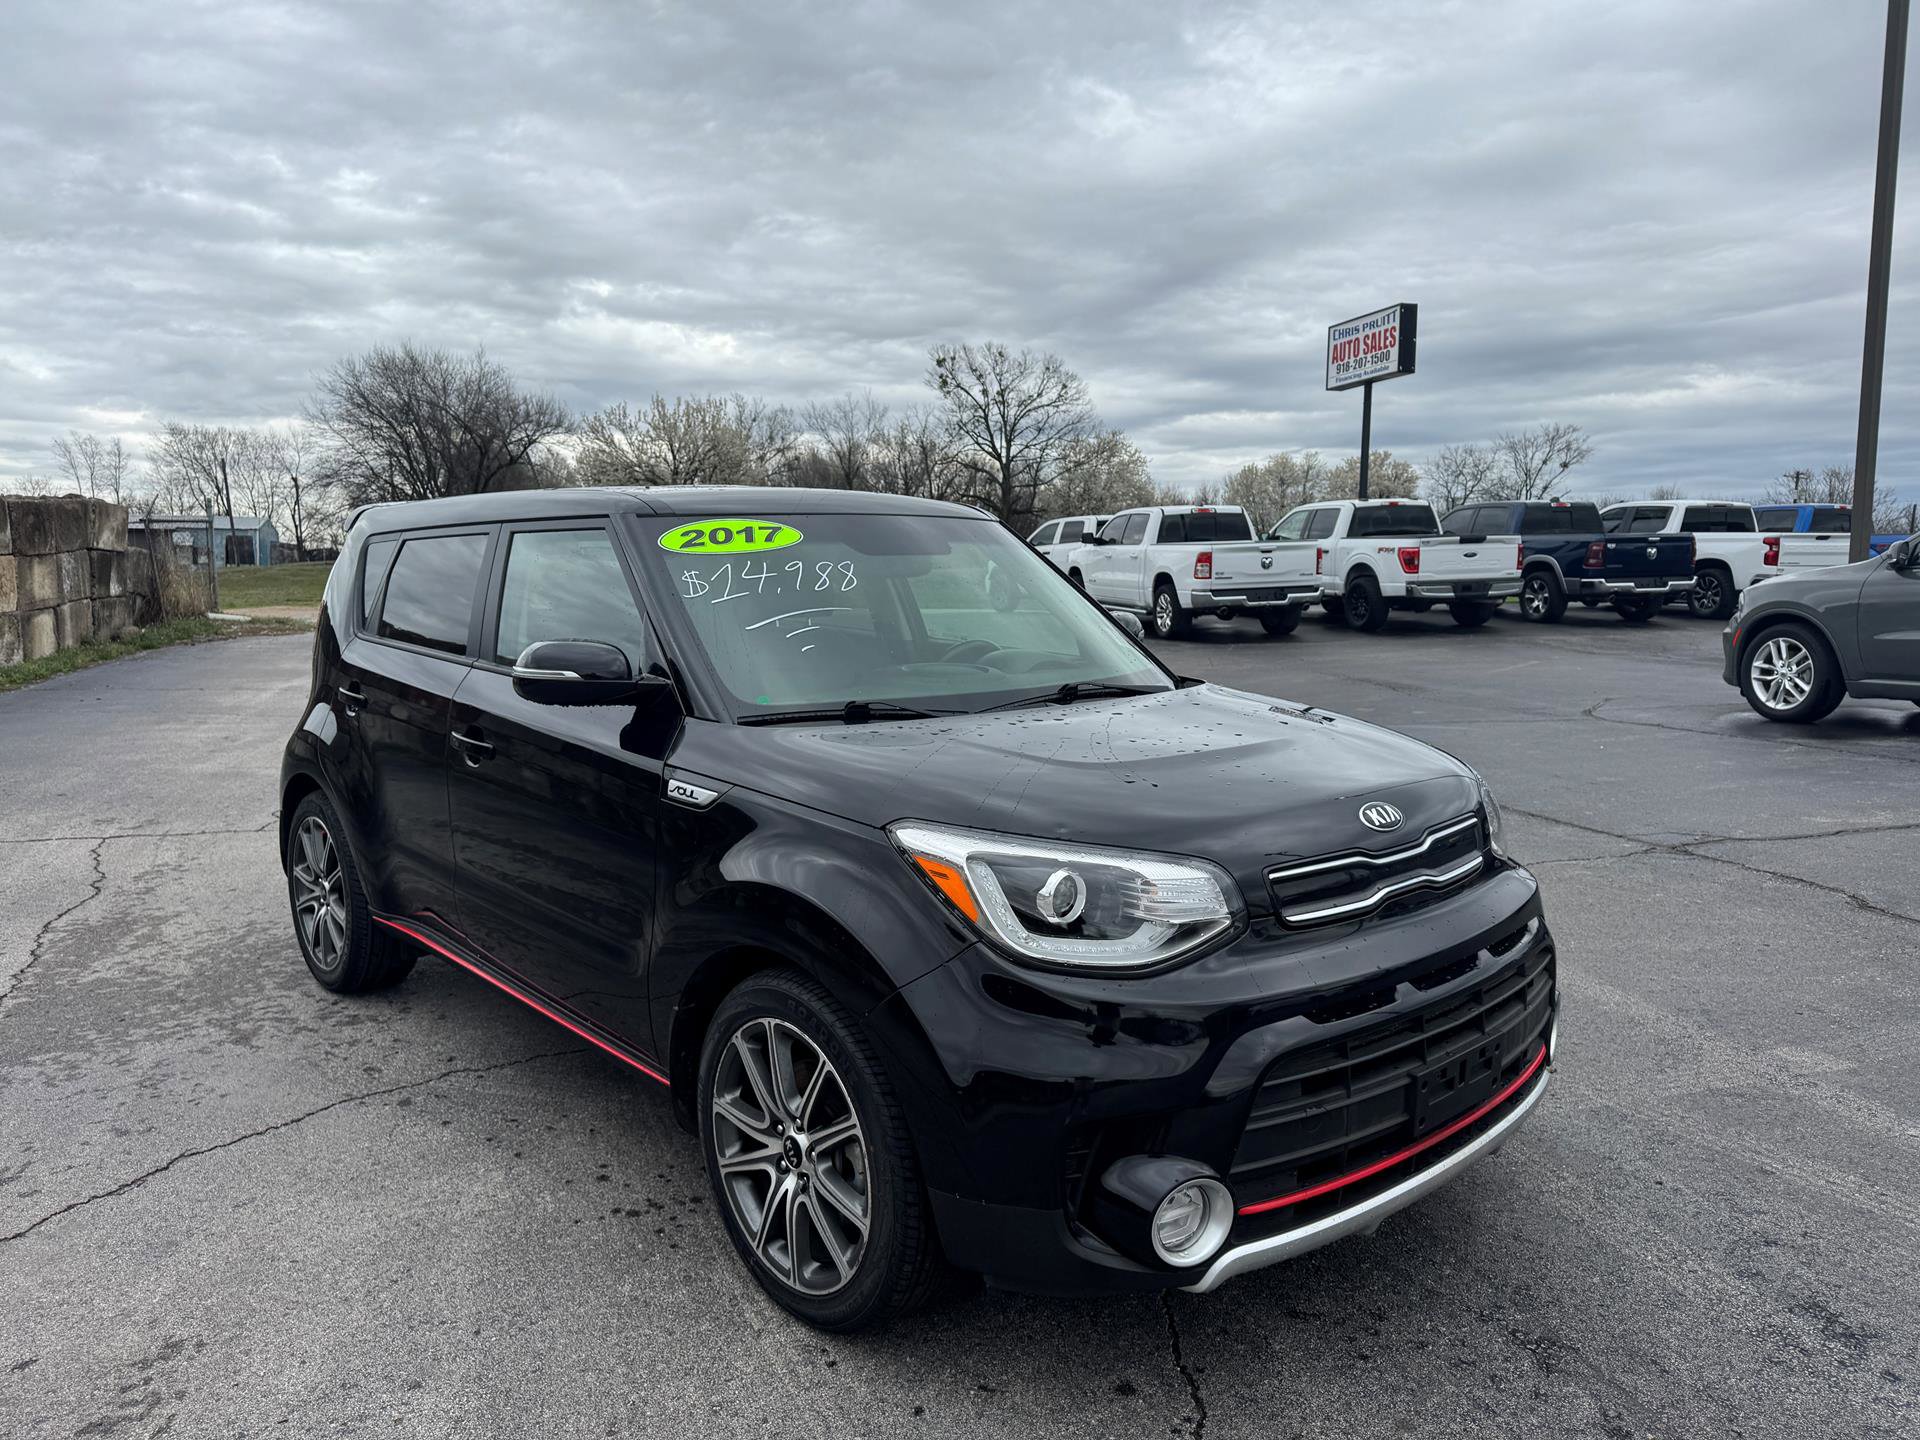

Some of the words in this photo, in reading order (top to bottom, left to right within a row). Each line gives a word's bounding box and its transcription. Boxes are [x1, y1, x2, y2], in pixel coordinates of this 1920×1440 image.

[1333, 325, 1360, 341] CHRIS
[1362, 309, 1398, 333] PRUITT
[1332, 337, 1361, 364] AUTO
[1363, 325, 1397, 356] SALES
[1336, 349, 1391, 375] 918-207-1500
[679, 526, 784, 549] 2017
